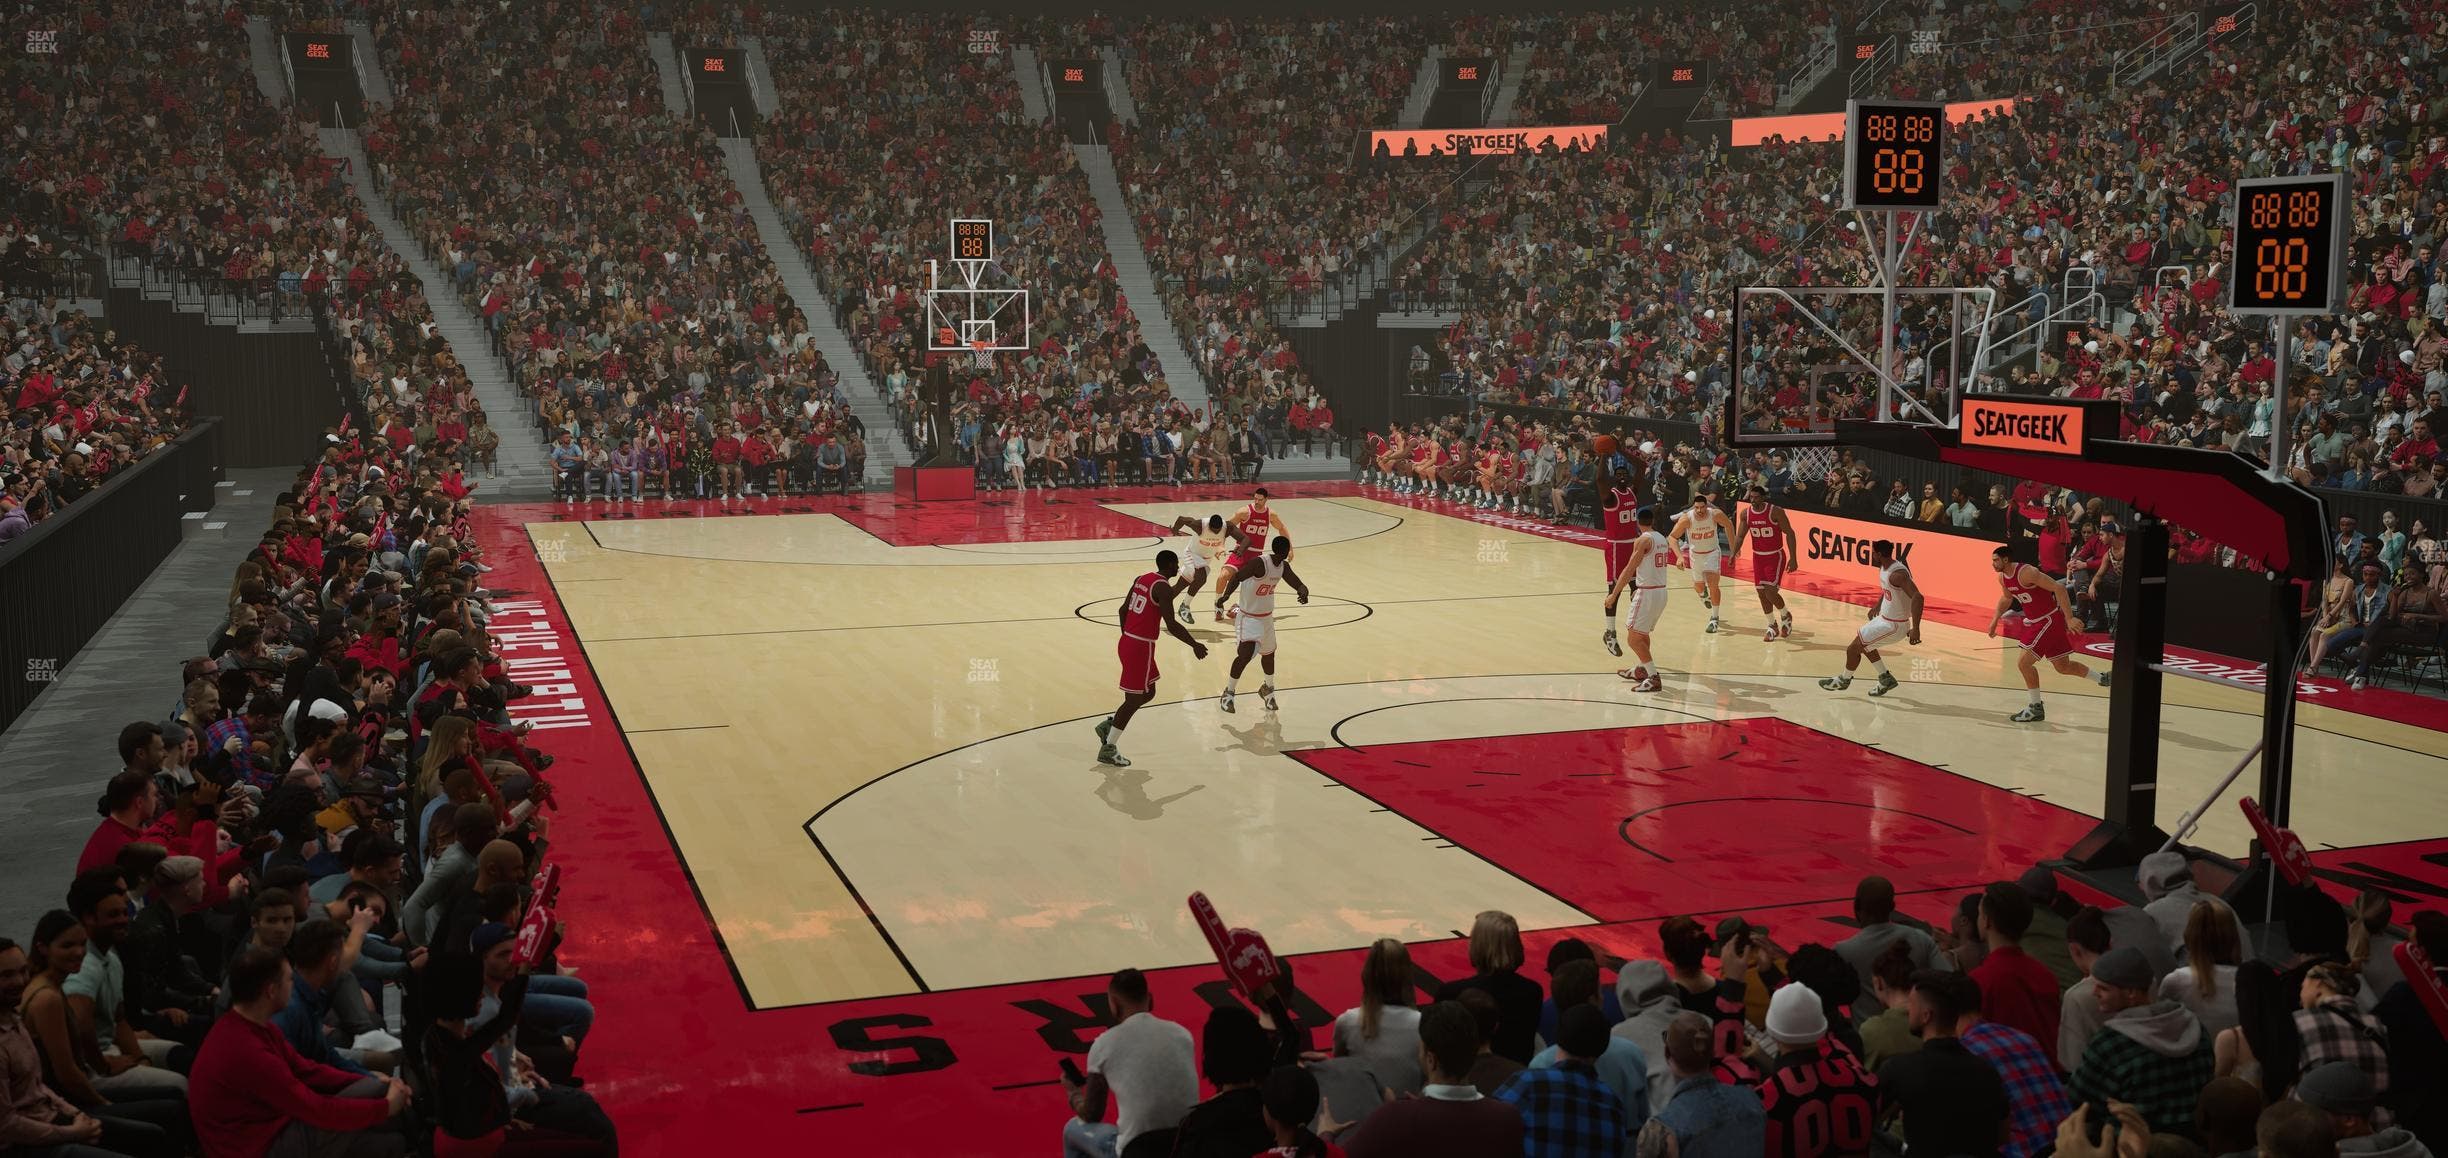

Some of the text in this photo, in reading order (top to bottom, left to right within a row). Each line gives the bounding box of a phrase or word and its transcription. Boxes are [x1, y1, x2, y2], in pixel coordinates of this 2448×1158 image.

[306, 50, 330, 58] GEEK
[307, 43, 329, 51] SEAT
[1867, 115, 1933, 143] 88 88
[1873, 148, 1924, 194] 88
[2251, 191, 2320, 229] 88 88
[962, 237, 983, 257] 88
[2255, 237, 2309, 299] 88
[1973, 408, 2069, 446] SEATGEEK
[1808, 526, 1914, 577] SEATGK
